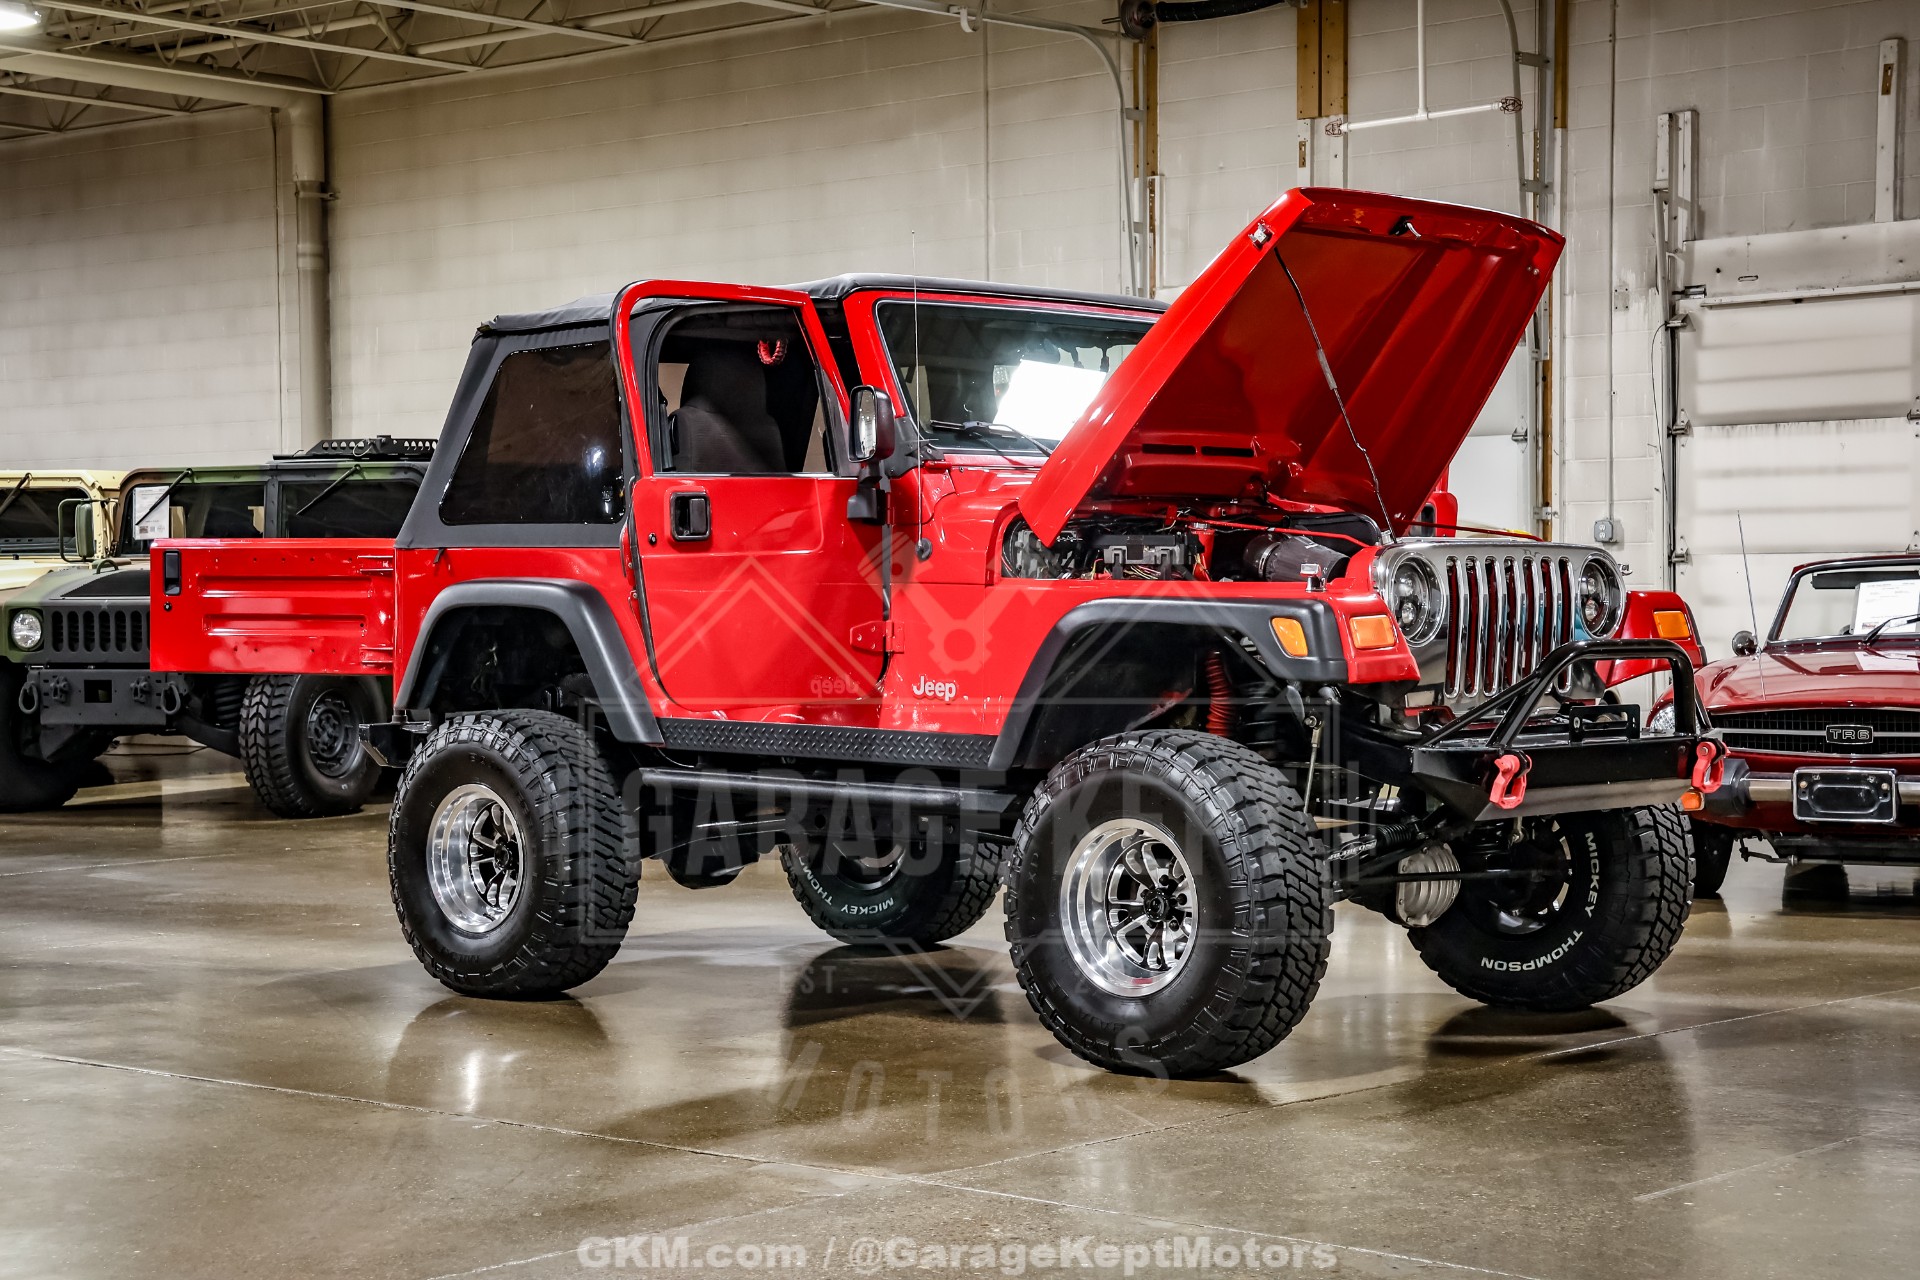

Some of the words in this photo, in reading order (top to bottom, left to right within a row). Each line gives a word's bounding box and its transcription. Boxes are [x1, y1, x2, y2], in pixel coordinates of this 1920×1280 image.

[913, 676, 956, 702] Jeep
[1830, 729, 1870, 740] TR6
[1584, 832, 1600, 918] MICKEY
[840, 897, 894, 915] MICKEY
[1481, 930, 1583, 972] THOMPSON
